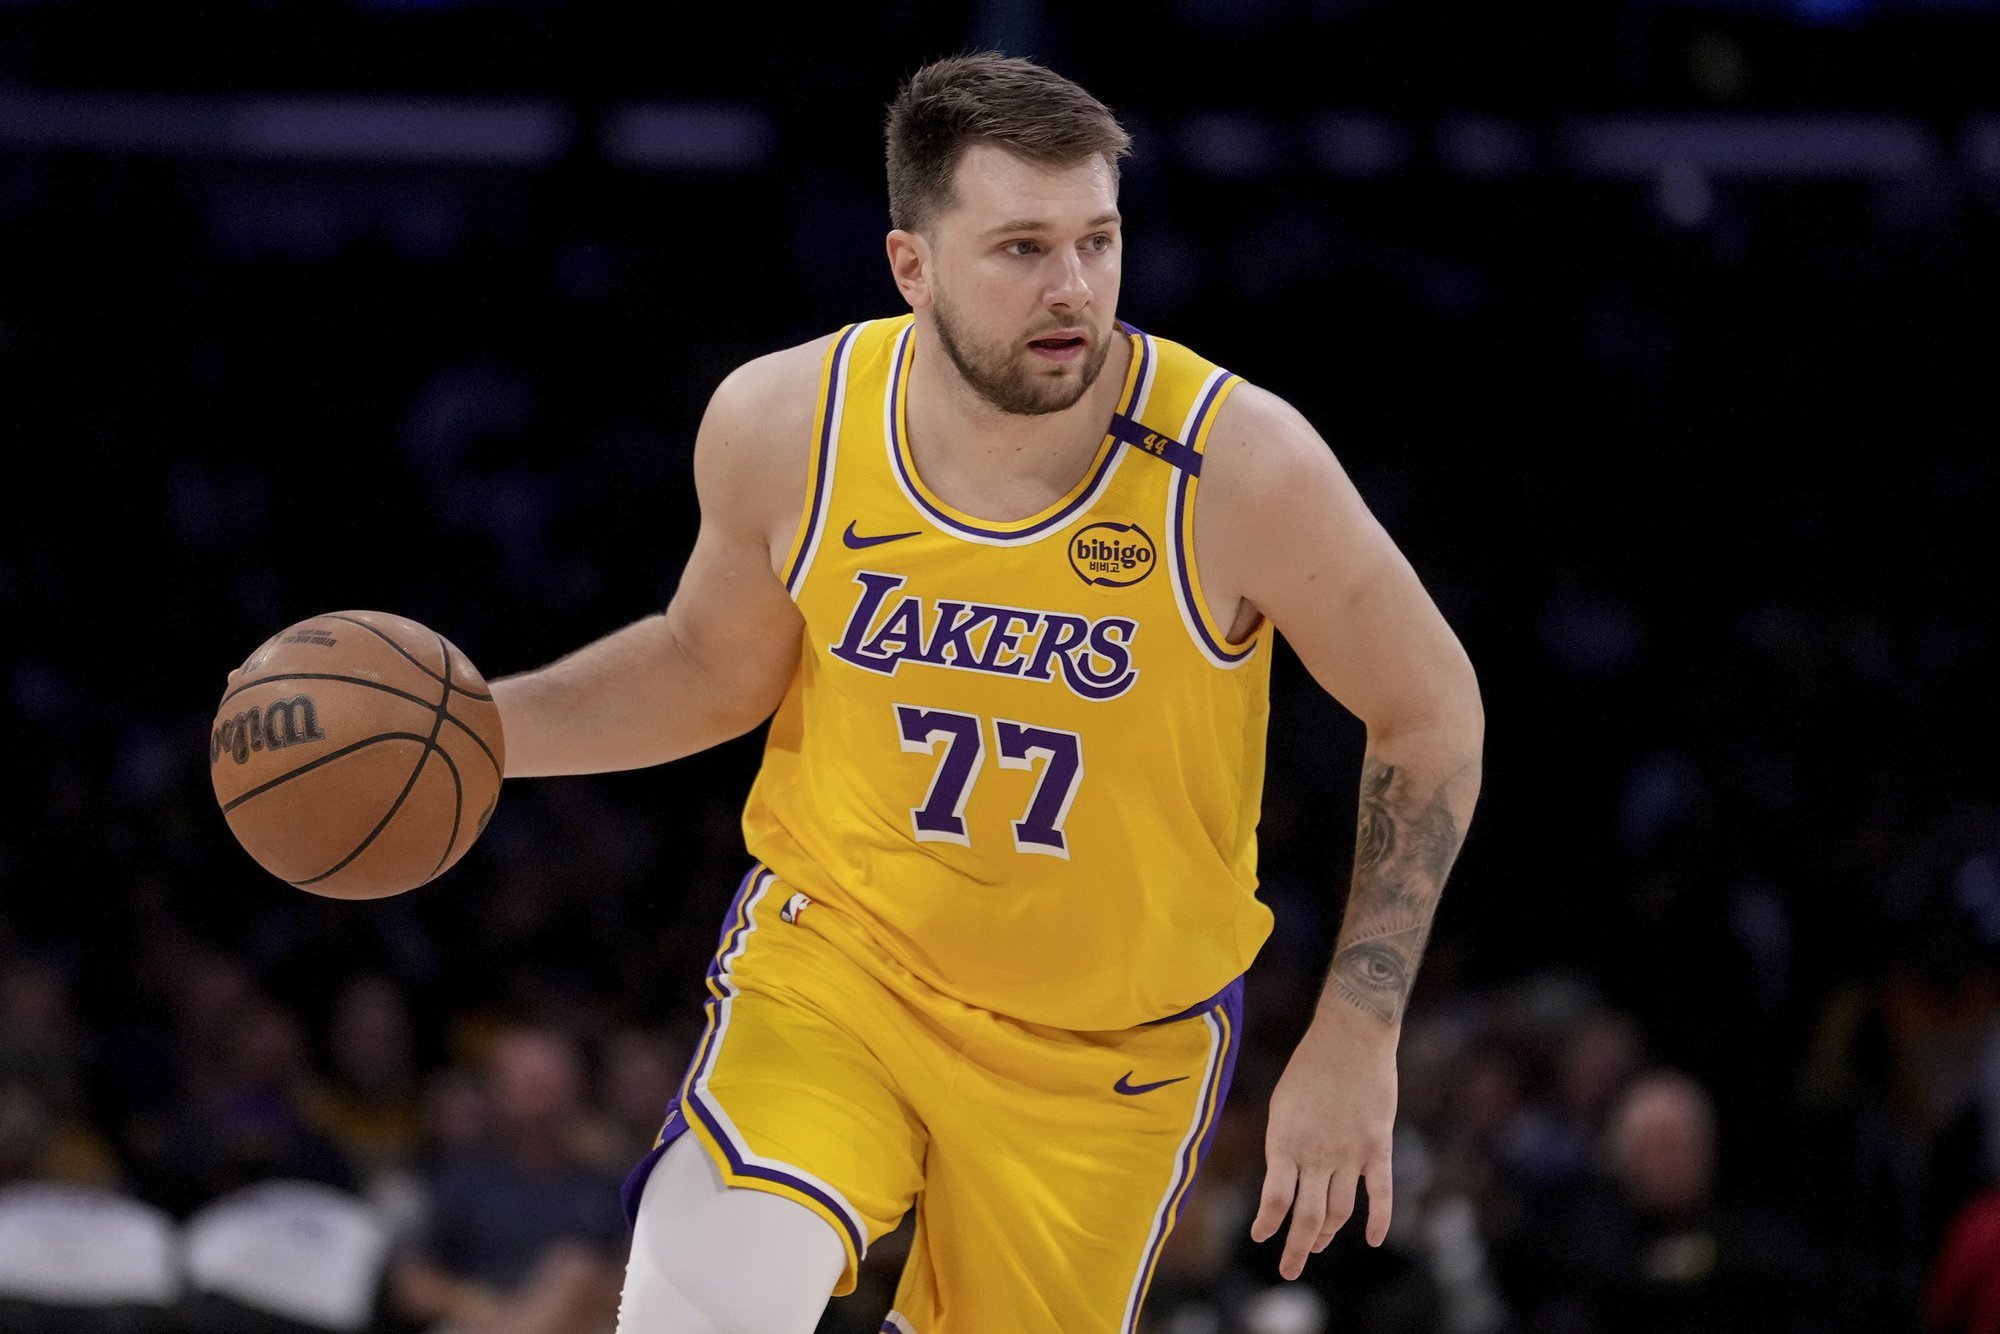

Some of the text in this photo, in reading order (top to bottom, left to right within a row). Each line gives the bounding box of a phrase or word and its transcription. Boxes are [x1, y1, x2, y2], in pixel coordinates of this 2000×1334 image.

[1143, 433, 1169, 455] 44
[1077, 538, 1151, 569] bibigo
[1089, 561, 1120, 573] 비비고
[828, 568, 1141, 703] LAKERS
[892, 702, 1085, 861] 77
